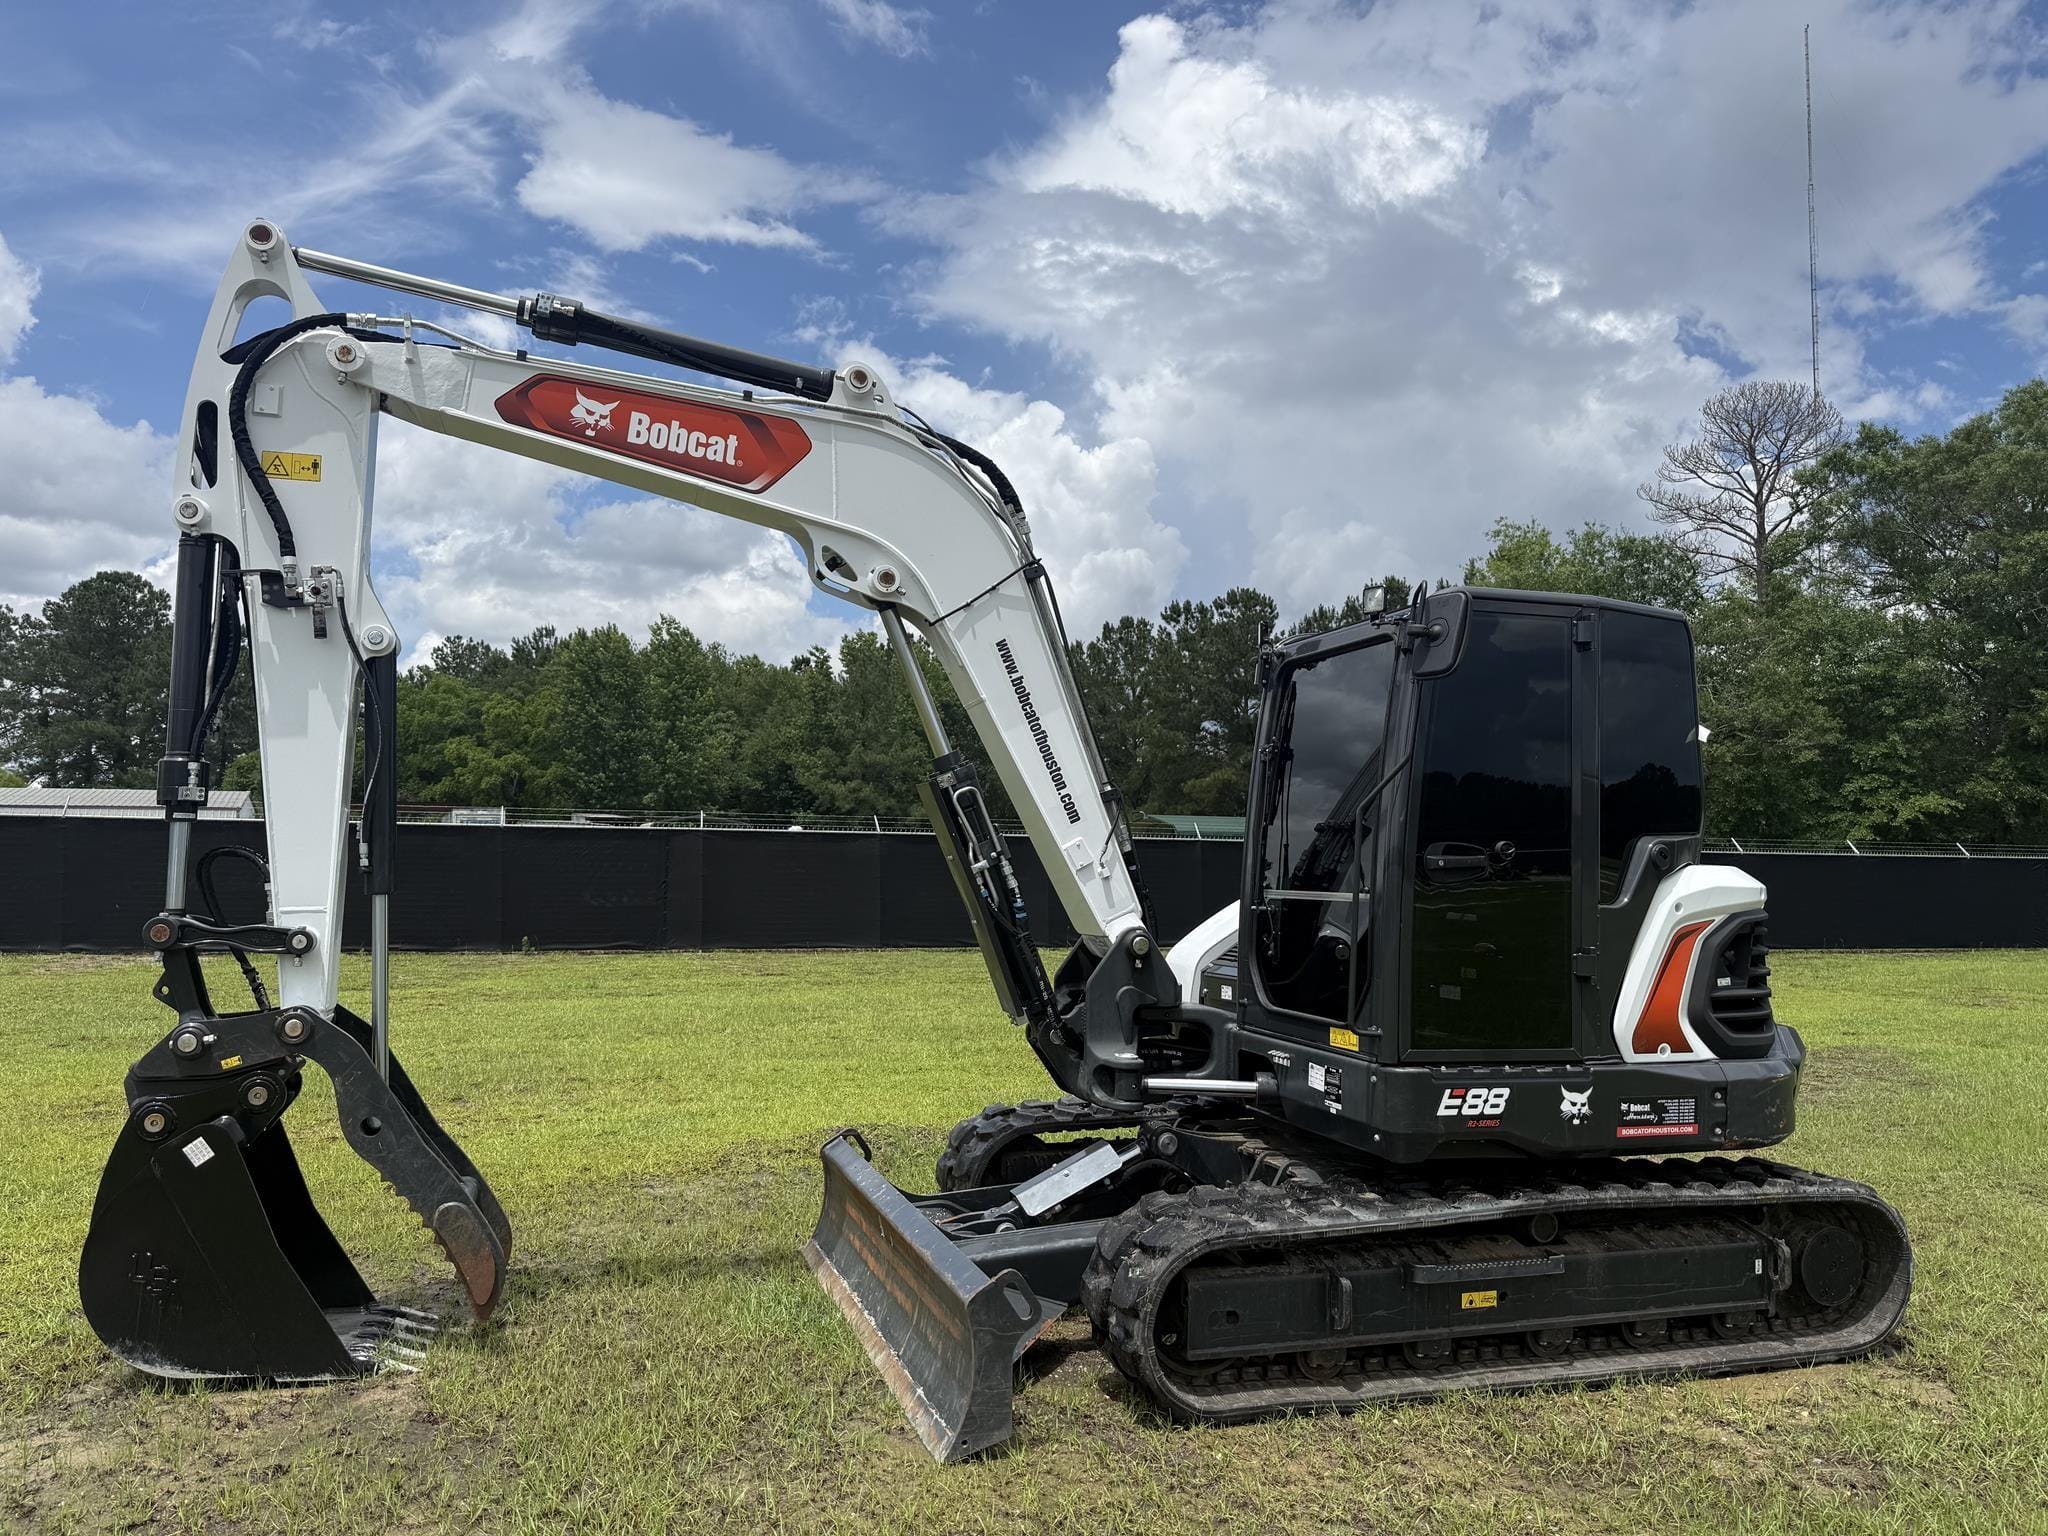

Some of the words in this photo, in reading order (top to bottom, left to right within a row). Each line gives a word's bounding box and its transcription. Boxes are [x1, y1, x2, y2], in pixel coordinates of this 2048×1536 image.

[627, 411, 738, 465] Bobcat
[995, 638, 1081, 825] www.bobcatofhouston.com
[1436, 1087, 1510, 1116] E88
[1630, 1103, 1650, 1112] Bobcat
[1467, 1119, 1500, 1128] R2-SERIES
[1621, 1126, 1693, 1135] BOBCATOFHOUSTON.COM
